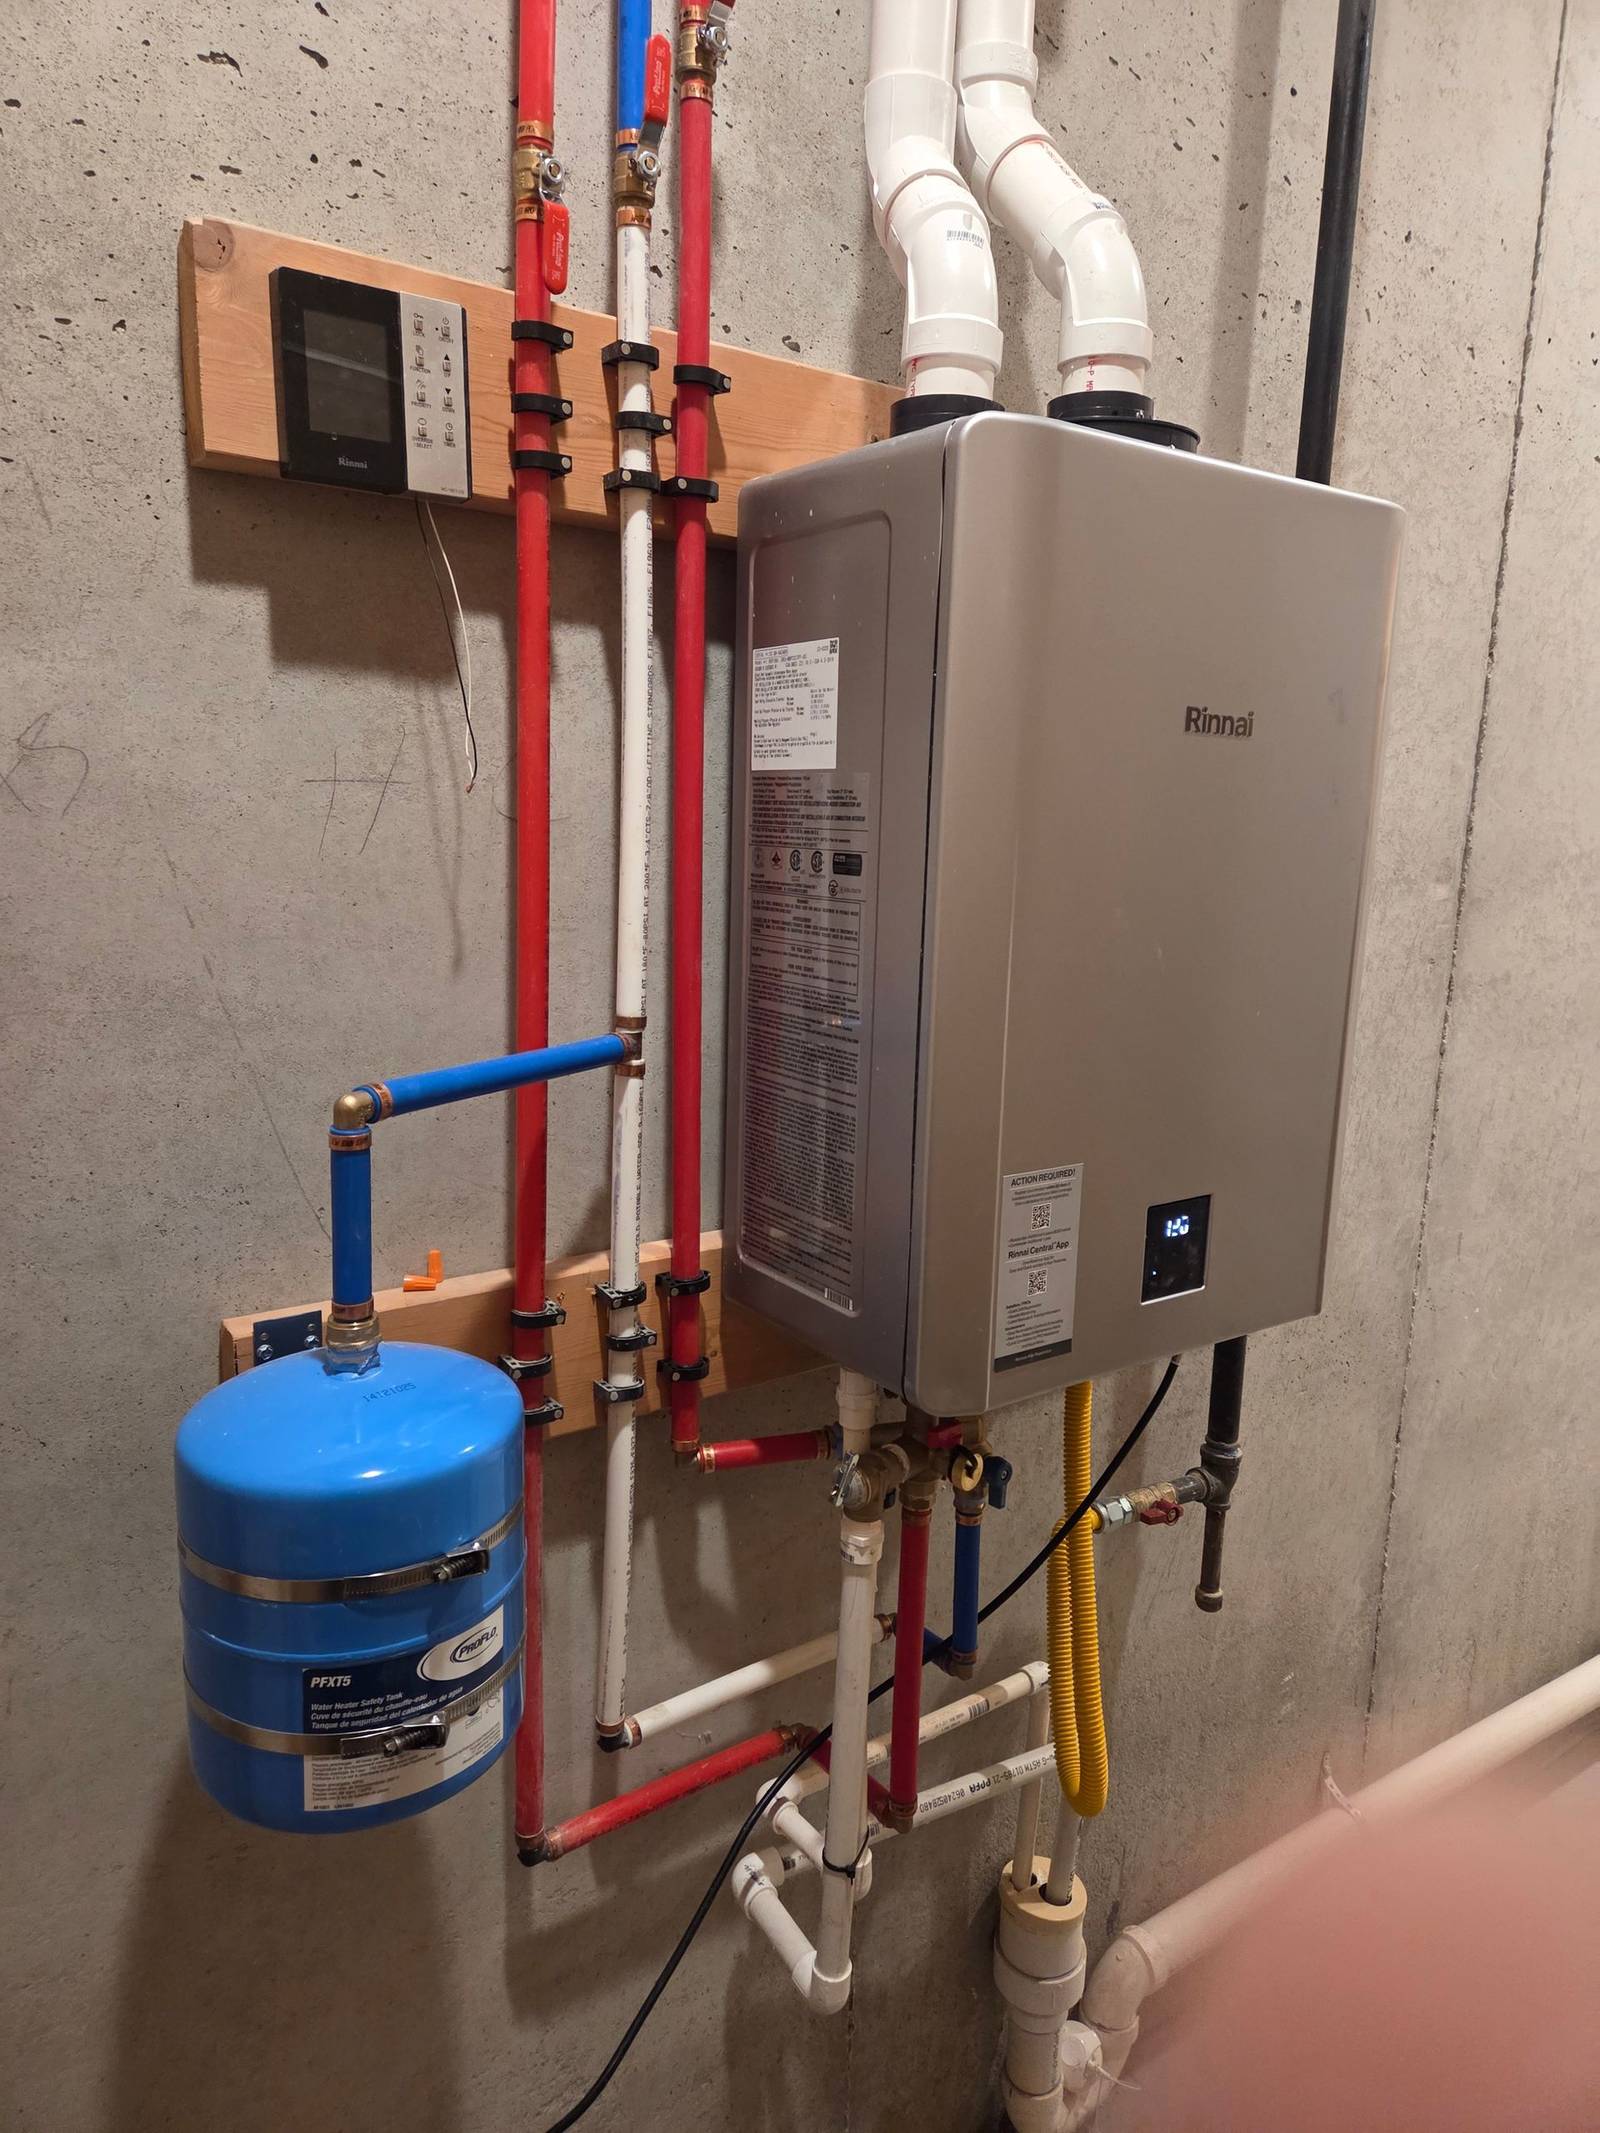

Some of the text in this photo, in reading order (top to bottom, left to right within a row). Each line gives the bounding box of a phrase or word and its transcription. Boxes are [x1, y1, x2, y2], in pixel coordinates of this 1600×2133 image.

[338, 456, 368, 469] Rinnai
[1184, 705, 1255, 738] Rinnai
[1011, 1168, 1076, 1187] ACTION REQUIRED!
[1008, 1248, 1029, 1259] Rinnai
[1056, 1240, 1070, 1250] App
[310, 1675, 352, 1689] PFXT5
[311, 1692, 403, 1711] Water Heater Safety Tank
[311, 1721, 338, 1730] Tanque
[339, 1719, 350, 1728] de
